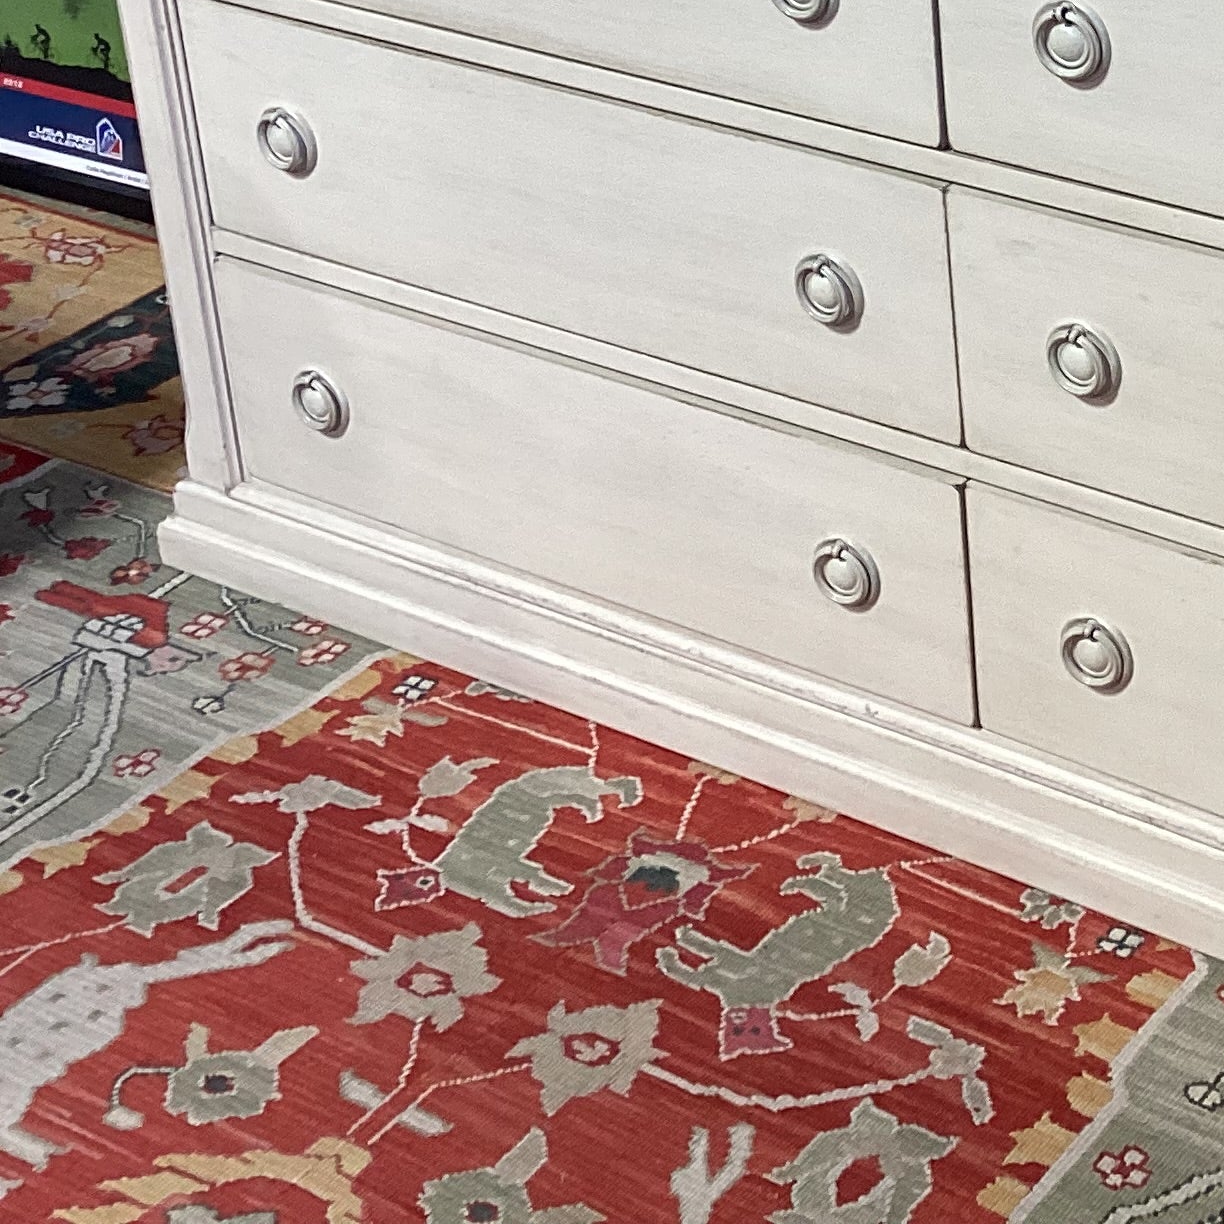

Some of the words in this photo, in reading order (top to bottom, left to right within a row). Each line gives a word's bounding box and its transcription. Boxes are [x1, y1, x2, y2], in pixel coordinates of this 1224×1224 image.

[27, 129, 96, 154] CHALLENGE
[35, 124, 64, 138] USA
[66, 132, 96, 147] PRO
